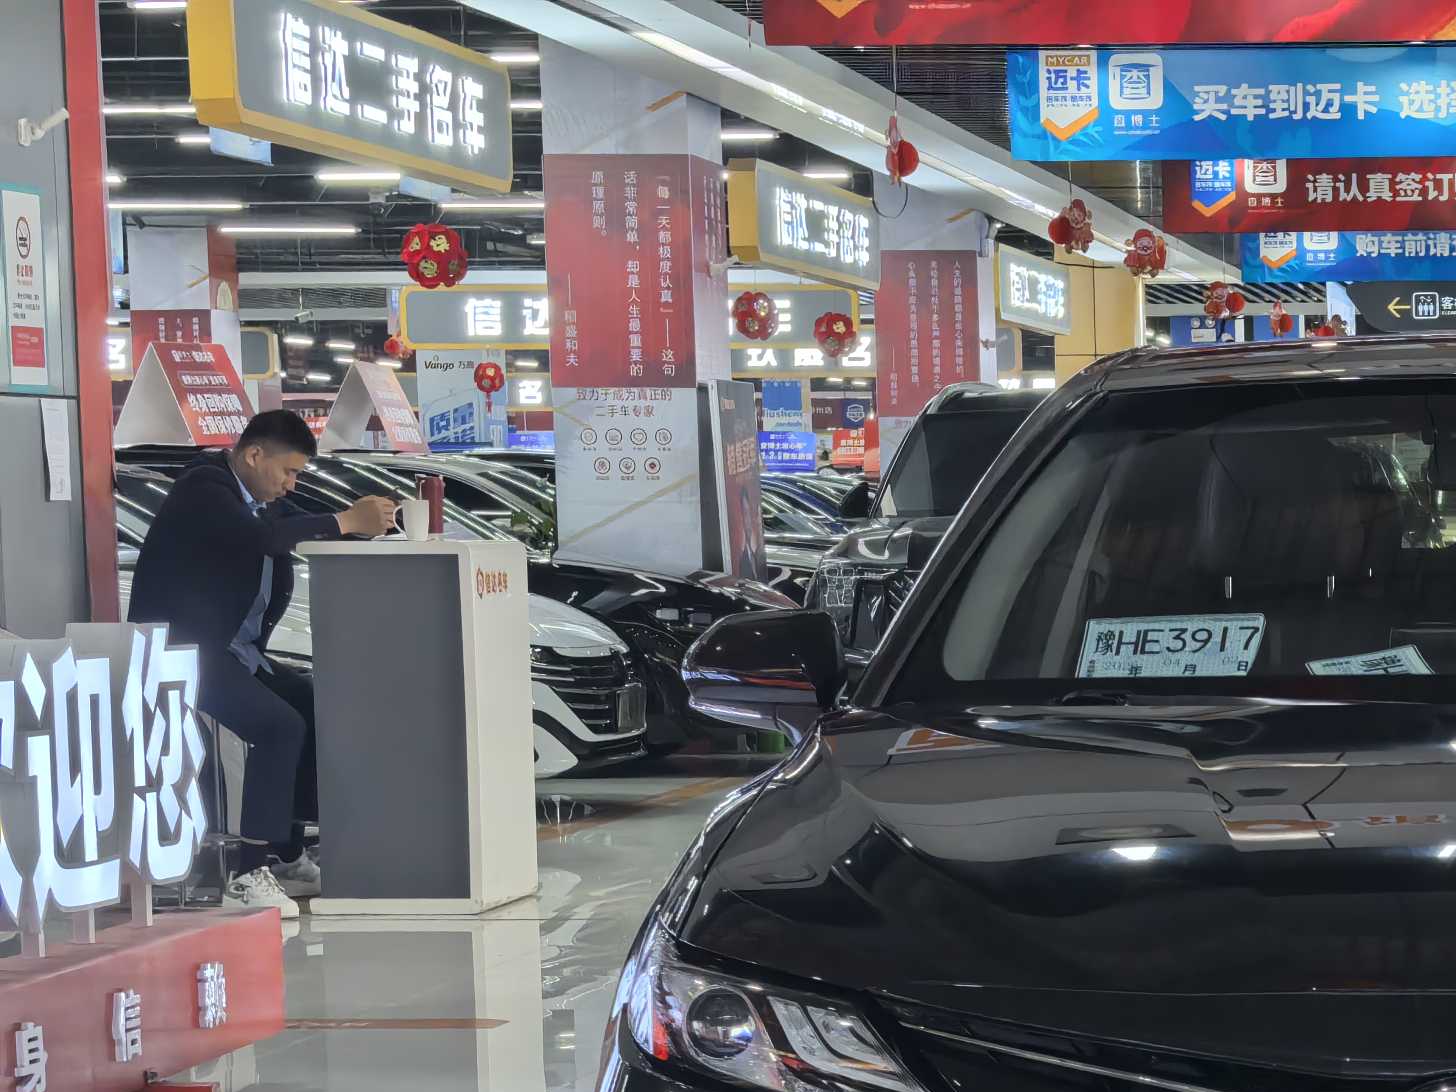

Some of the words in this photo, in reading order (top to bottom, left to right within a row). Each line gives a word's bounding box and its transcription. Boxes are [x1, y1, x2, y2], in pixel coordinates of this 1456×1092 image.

[1047, 56, 1089, 66] MYCAR
[279, 12, 486, 154] 信达二手名车
[1046, 68, 1091, 91] 迈卡
[1192, 82, 1380, 121] 买车到迈卡
[1195, 160, 1231, 179] 迈卡
[424, 361, 455, 372] Vango
[1095, 626, 1261, 656] 豫HE3917
[0, 625, 206, 930] 迎您
